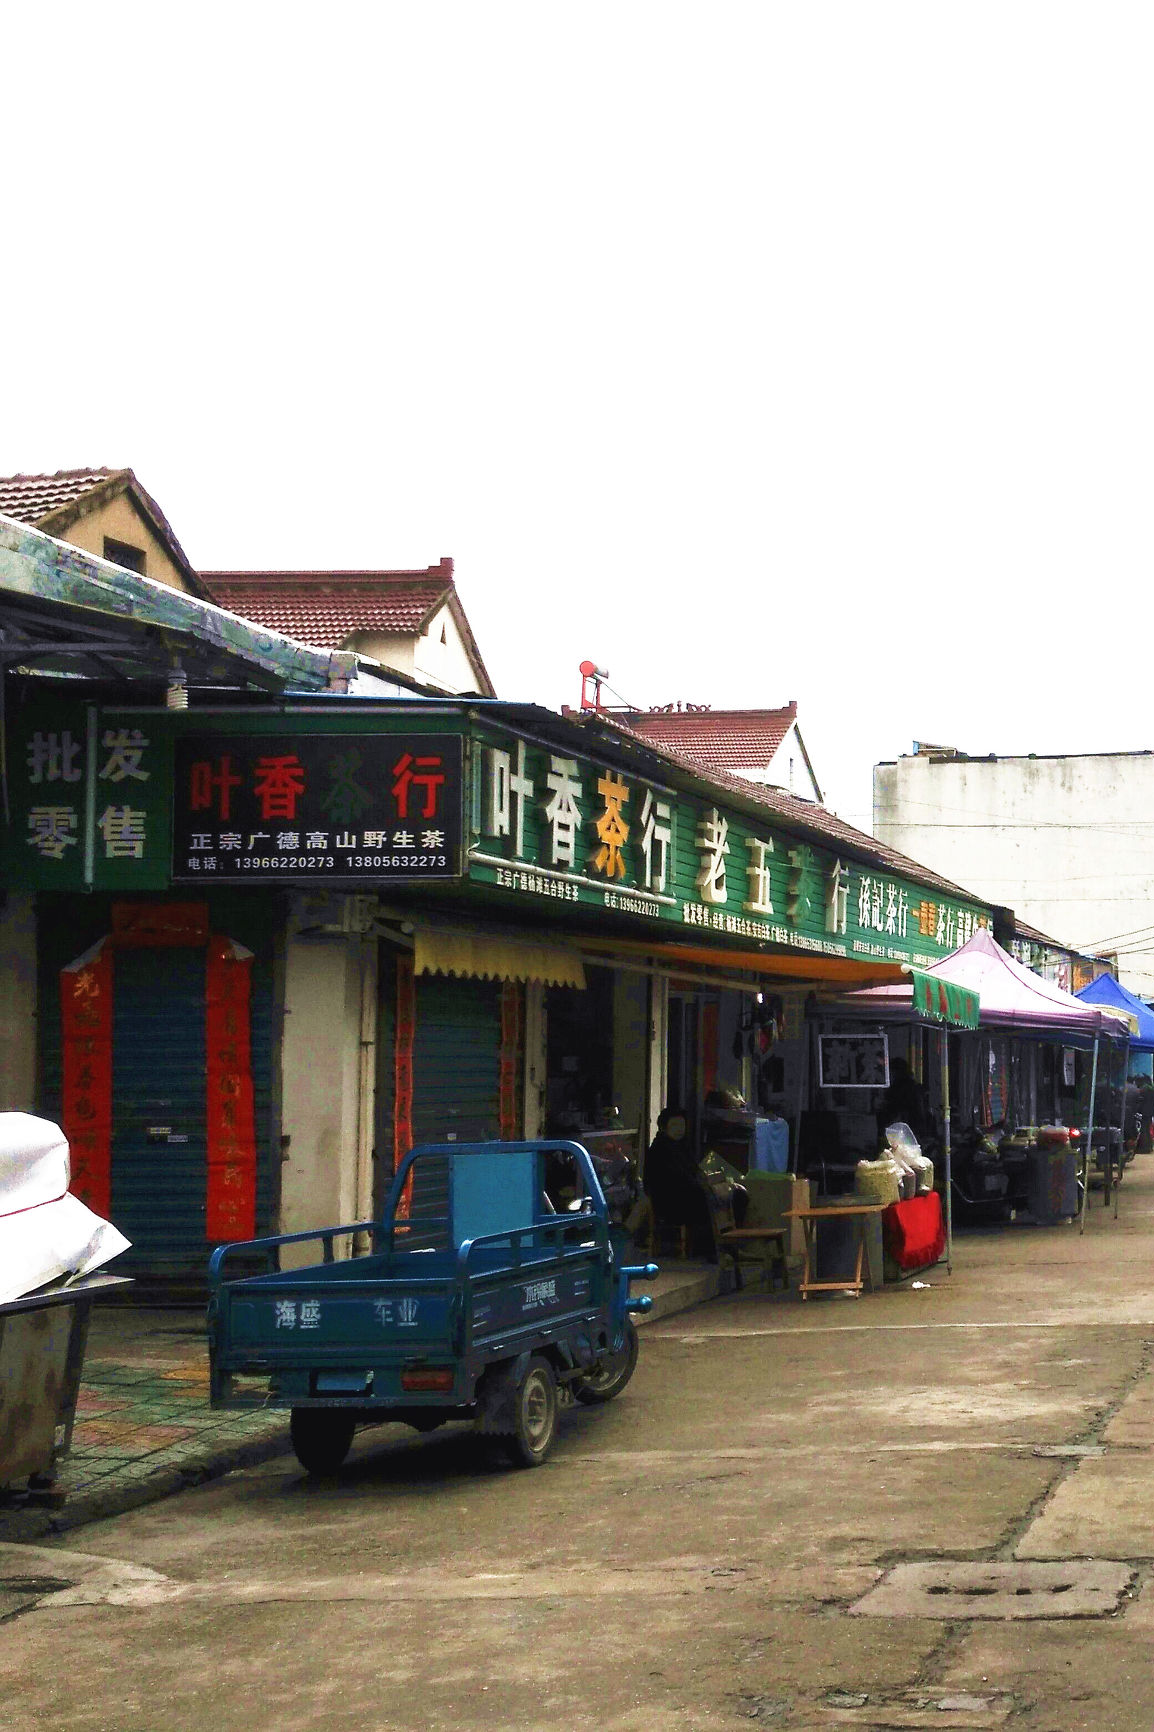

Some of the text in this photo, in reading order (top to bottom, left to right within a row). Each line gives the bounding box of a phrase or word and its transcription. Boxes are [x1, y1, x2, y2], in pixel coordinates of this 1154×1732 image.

[27, 729, 151, 782] 批发
[190, 747, 445, 823] 叶香茶行
[27, 805, 147, 860] 零售
[189, 830, 446, 851] 正宗广德高山野生茶
[482, 740, 674, 892] 叶香茶行
[234, 855, 335, 870] 13966220273
[346, 855, 447, 869] 13805632273
[695, 807, 851, 935] 老五茶行
[373, 1297, 420, 1327] 车业
